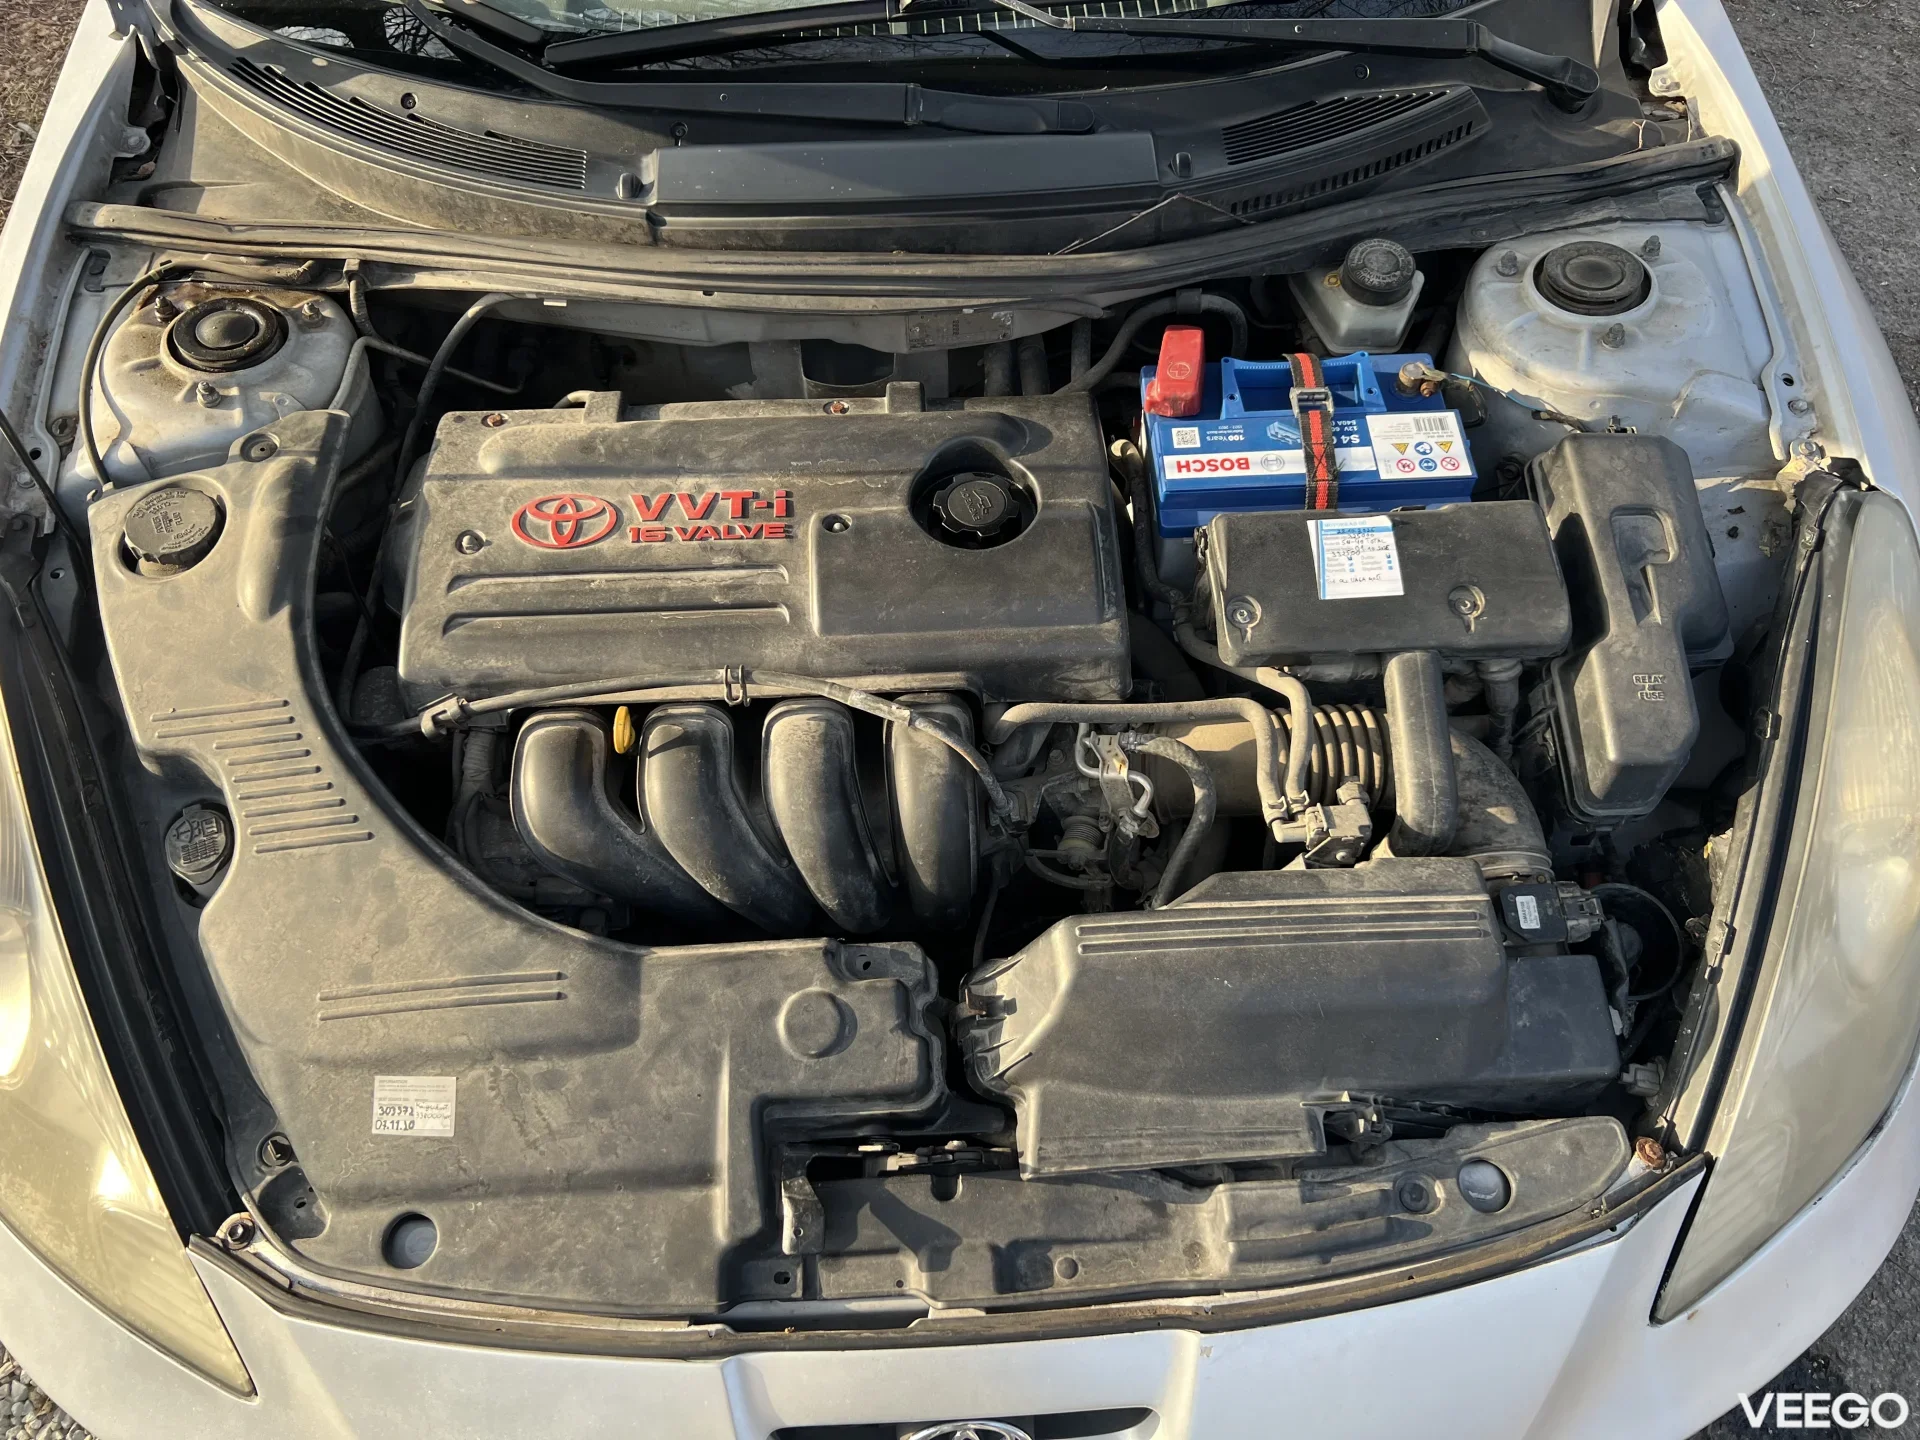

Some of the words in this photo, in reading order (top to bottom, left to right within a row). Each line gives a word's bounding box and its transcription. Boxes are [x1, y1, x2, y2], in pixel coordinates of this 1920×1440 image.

[1340, 434, 1360, 444] S4
[1176, 457, 1251, 473] BOSCH
[630, 490, 788, 522] VVT-i
[628, 526, 668, 543] 16
[674, 523, 788, 542] VALVE
[1634, 674, 1667, 684] RELAY
[1639, 691, 1666, 700] FUSE
